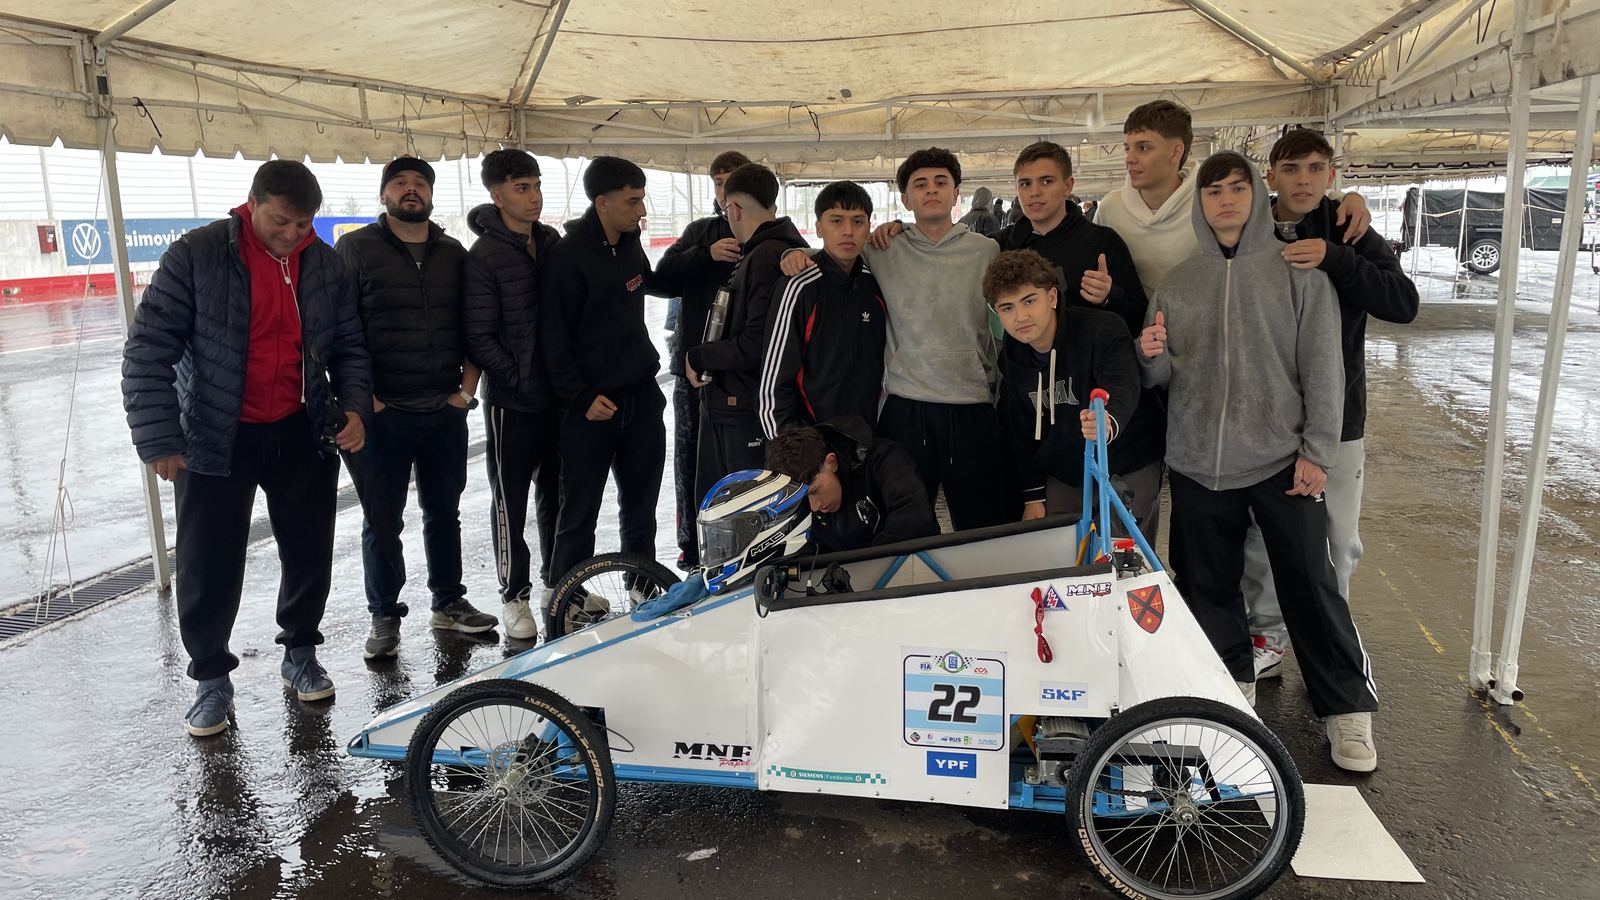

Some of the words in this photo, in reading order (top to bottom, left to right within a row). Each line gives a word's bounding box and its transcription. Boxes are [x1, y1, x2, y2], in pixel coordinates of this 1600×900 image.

[1067, 582, 1111, 596] MNF
[1042, 688, 1086, 701] SKF
[928, 684, 981, 723] 22
[672, 742, 752, 761] MNF
[587, 750, 604, 788] CORD
[719, 757, 752, 768] Papel
[934, 758, 969, 770] YPF
[798, 771, 824, 779] SIEMENS
[1077, 828, 1100, 865] CORD
